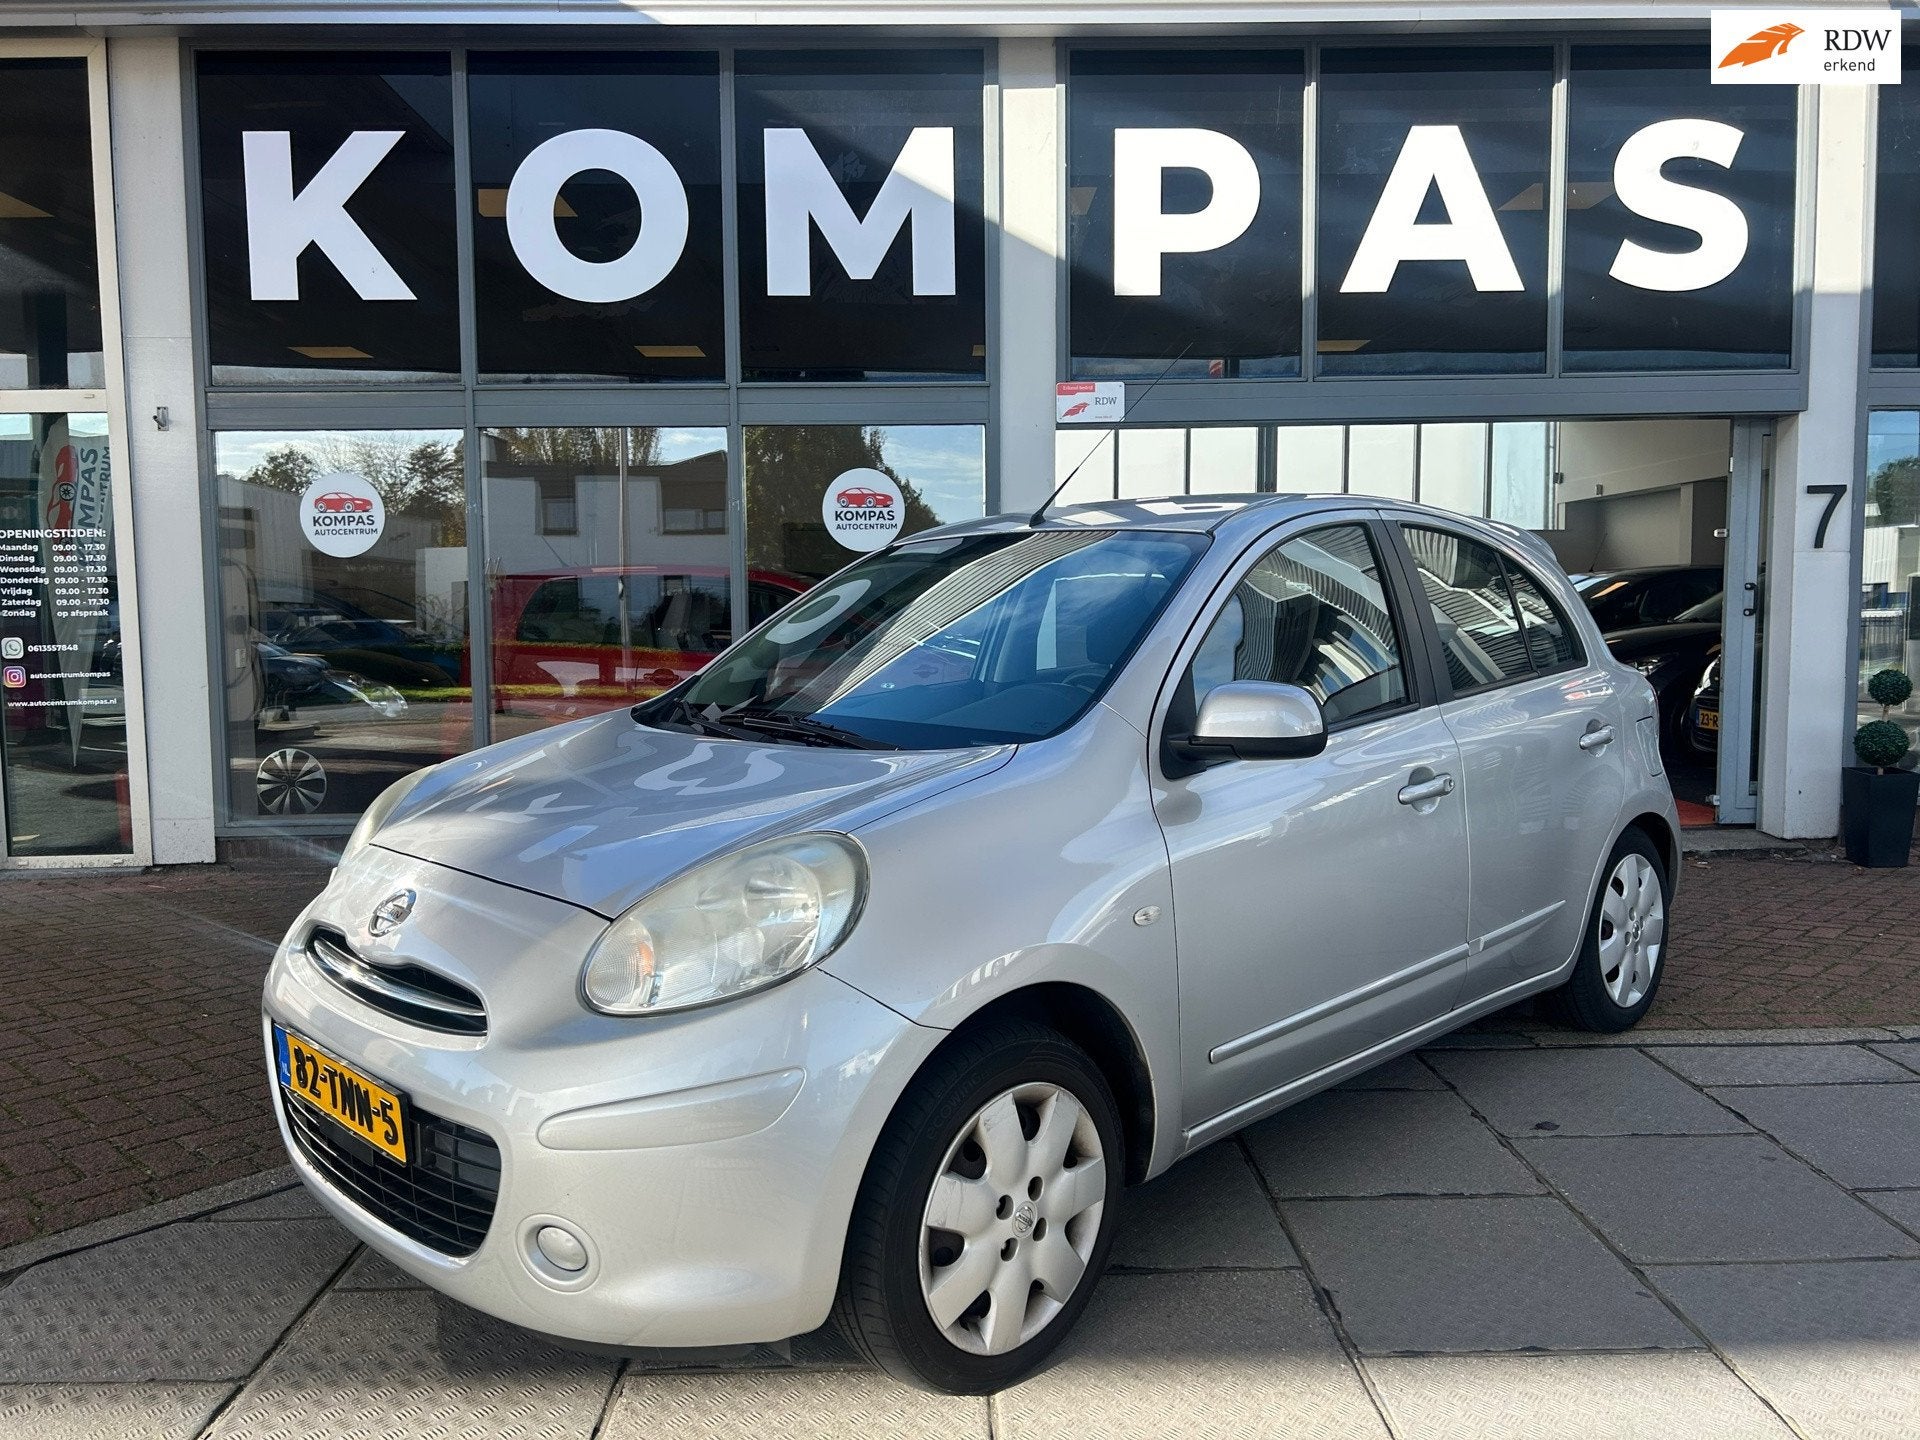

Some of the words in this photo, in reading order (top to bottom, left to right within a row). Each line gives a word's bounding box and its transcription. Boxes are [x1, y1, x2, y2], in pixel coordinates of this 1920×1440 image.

[242, 118, 1749, 303] KOMPAS
[1094, 396, 1117, 406] RDW
[834, 510, 895, 521] KOMPAS
[1806, 484, 1848, 549] 7
[312, 514, 375, 527] KOMPAS
[836, 523, 898, 531] AUTOCENTRUM
[0, 528, 106, 539] OPENINGSTIJDEN:
[314, 528, 378, 536] AUTOCENTRUM
[0, 554, 35, 563] Dinsdag
[0, 566, 46, 574] Woensdag
[0, 576, 50, 585] Donderdag
[1, 587, 33, 596] Vrijdag
[1, 599, 42, 607] Zaterdag
[2, 609, 36, 618] Zondag
[70, 609, 109, 617] afspraak
[27, 644, 79, 652] 0613557848
[30, 671, 111, 680] autocentrumkompas
[7, 698, 117, 707] www.autocentrumkompas.nl
[294, 1046, 399, 1146] 82-TNN-5
